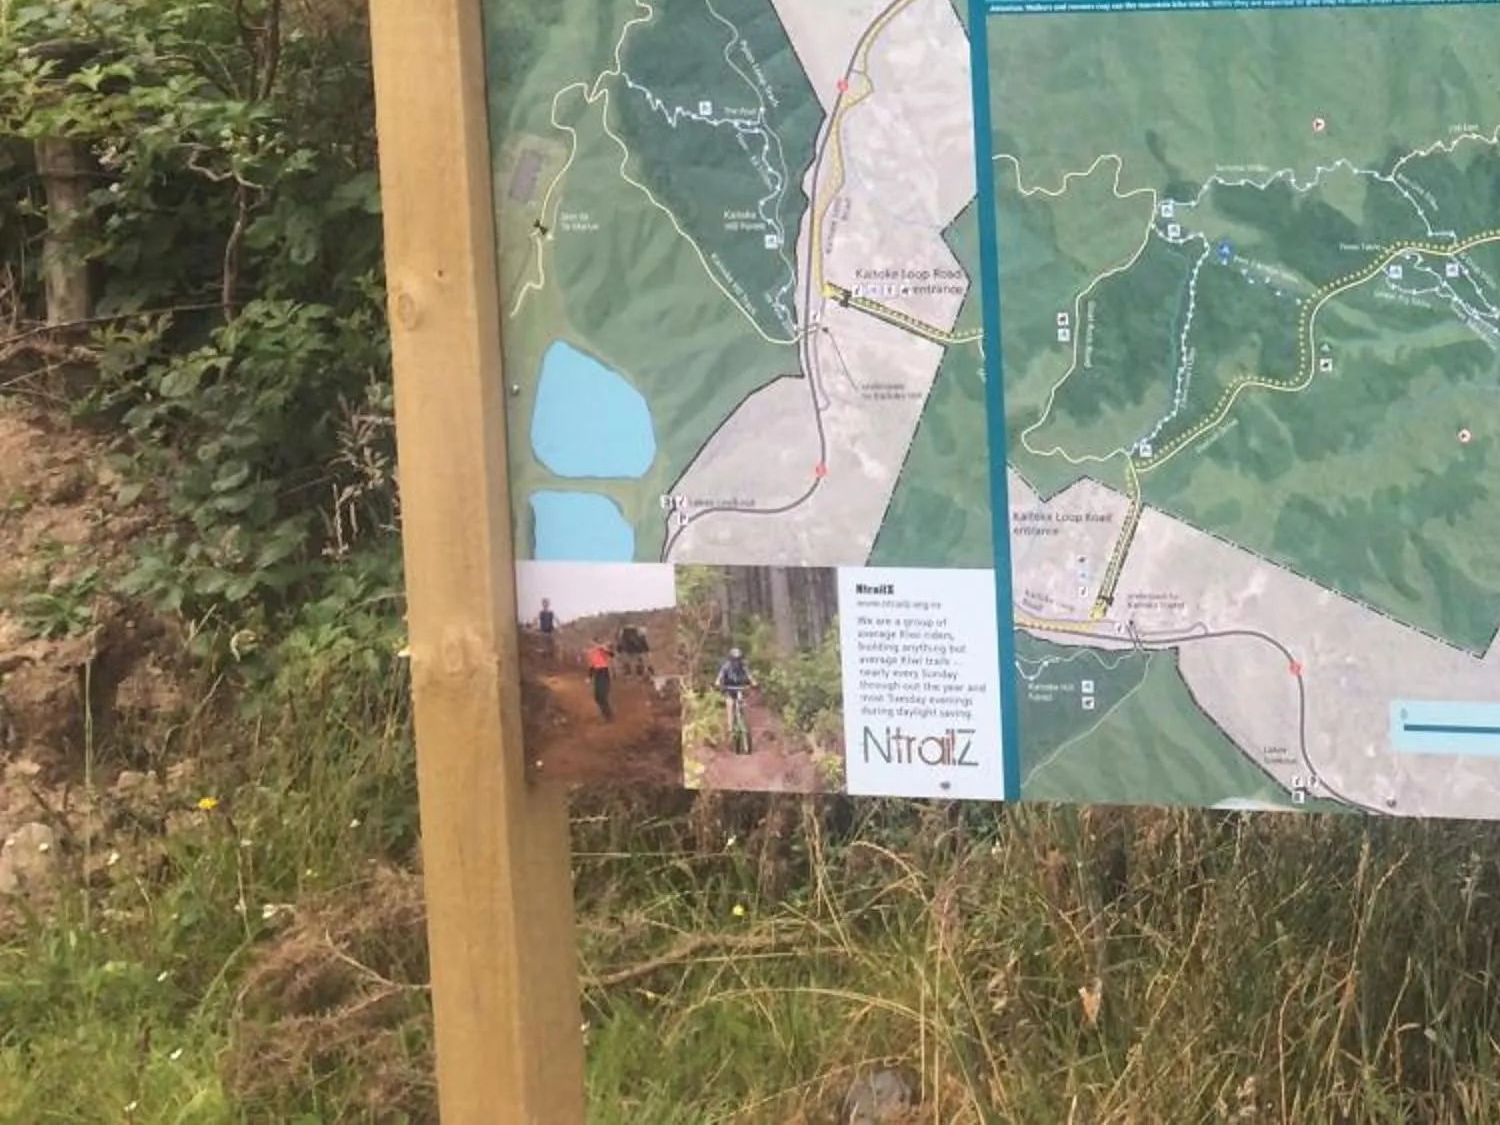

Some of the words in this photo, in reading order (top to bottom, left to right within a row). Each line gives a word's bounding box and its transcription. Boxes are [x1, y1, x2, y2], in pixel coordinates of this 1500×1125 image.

[901, 269, 930, 281] Loop
[933, 268, 962, 278] Road
[913, 285, 963, 294] entrance
[1056, 512, 1083, 525] Loop
[1086, 513, 1113, 523] Road
[1013, 526, 1059, 536] entrance
